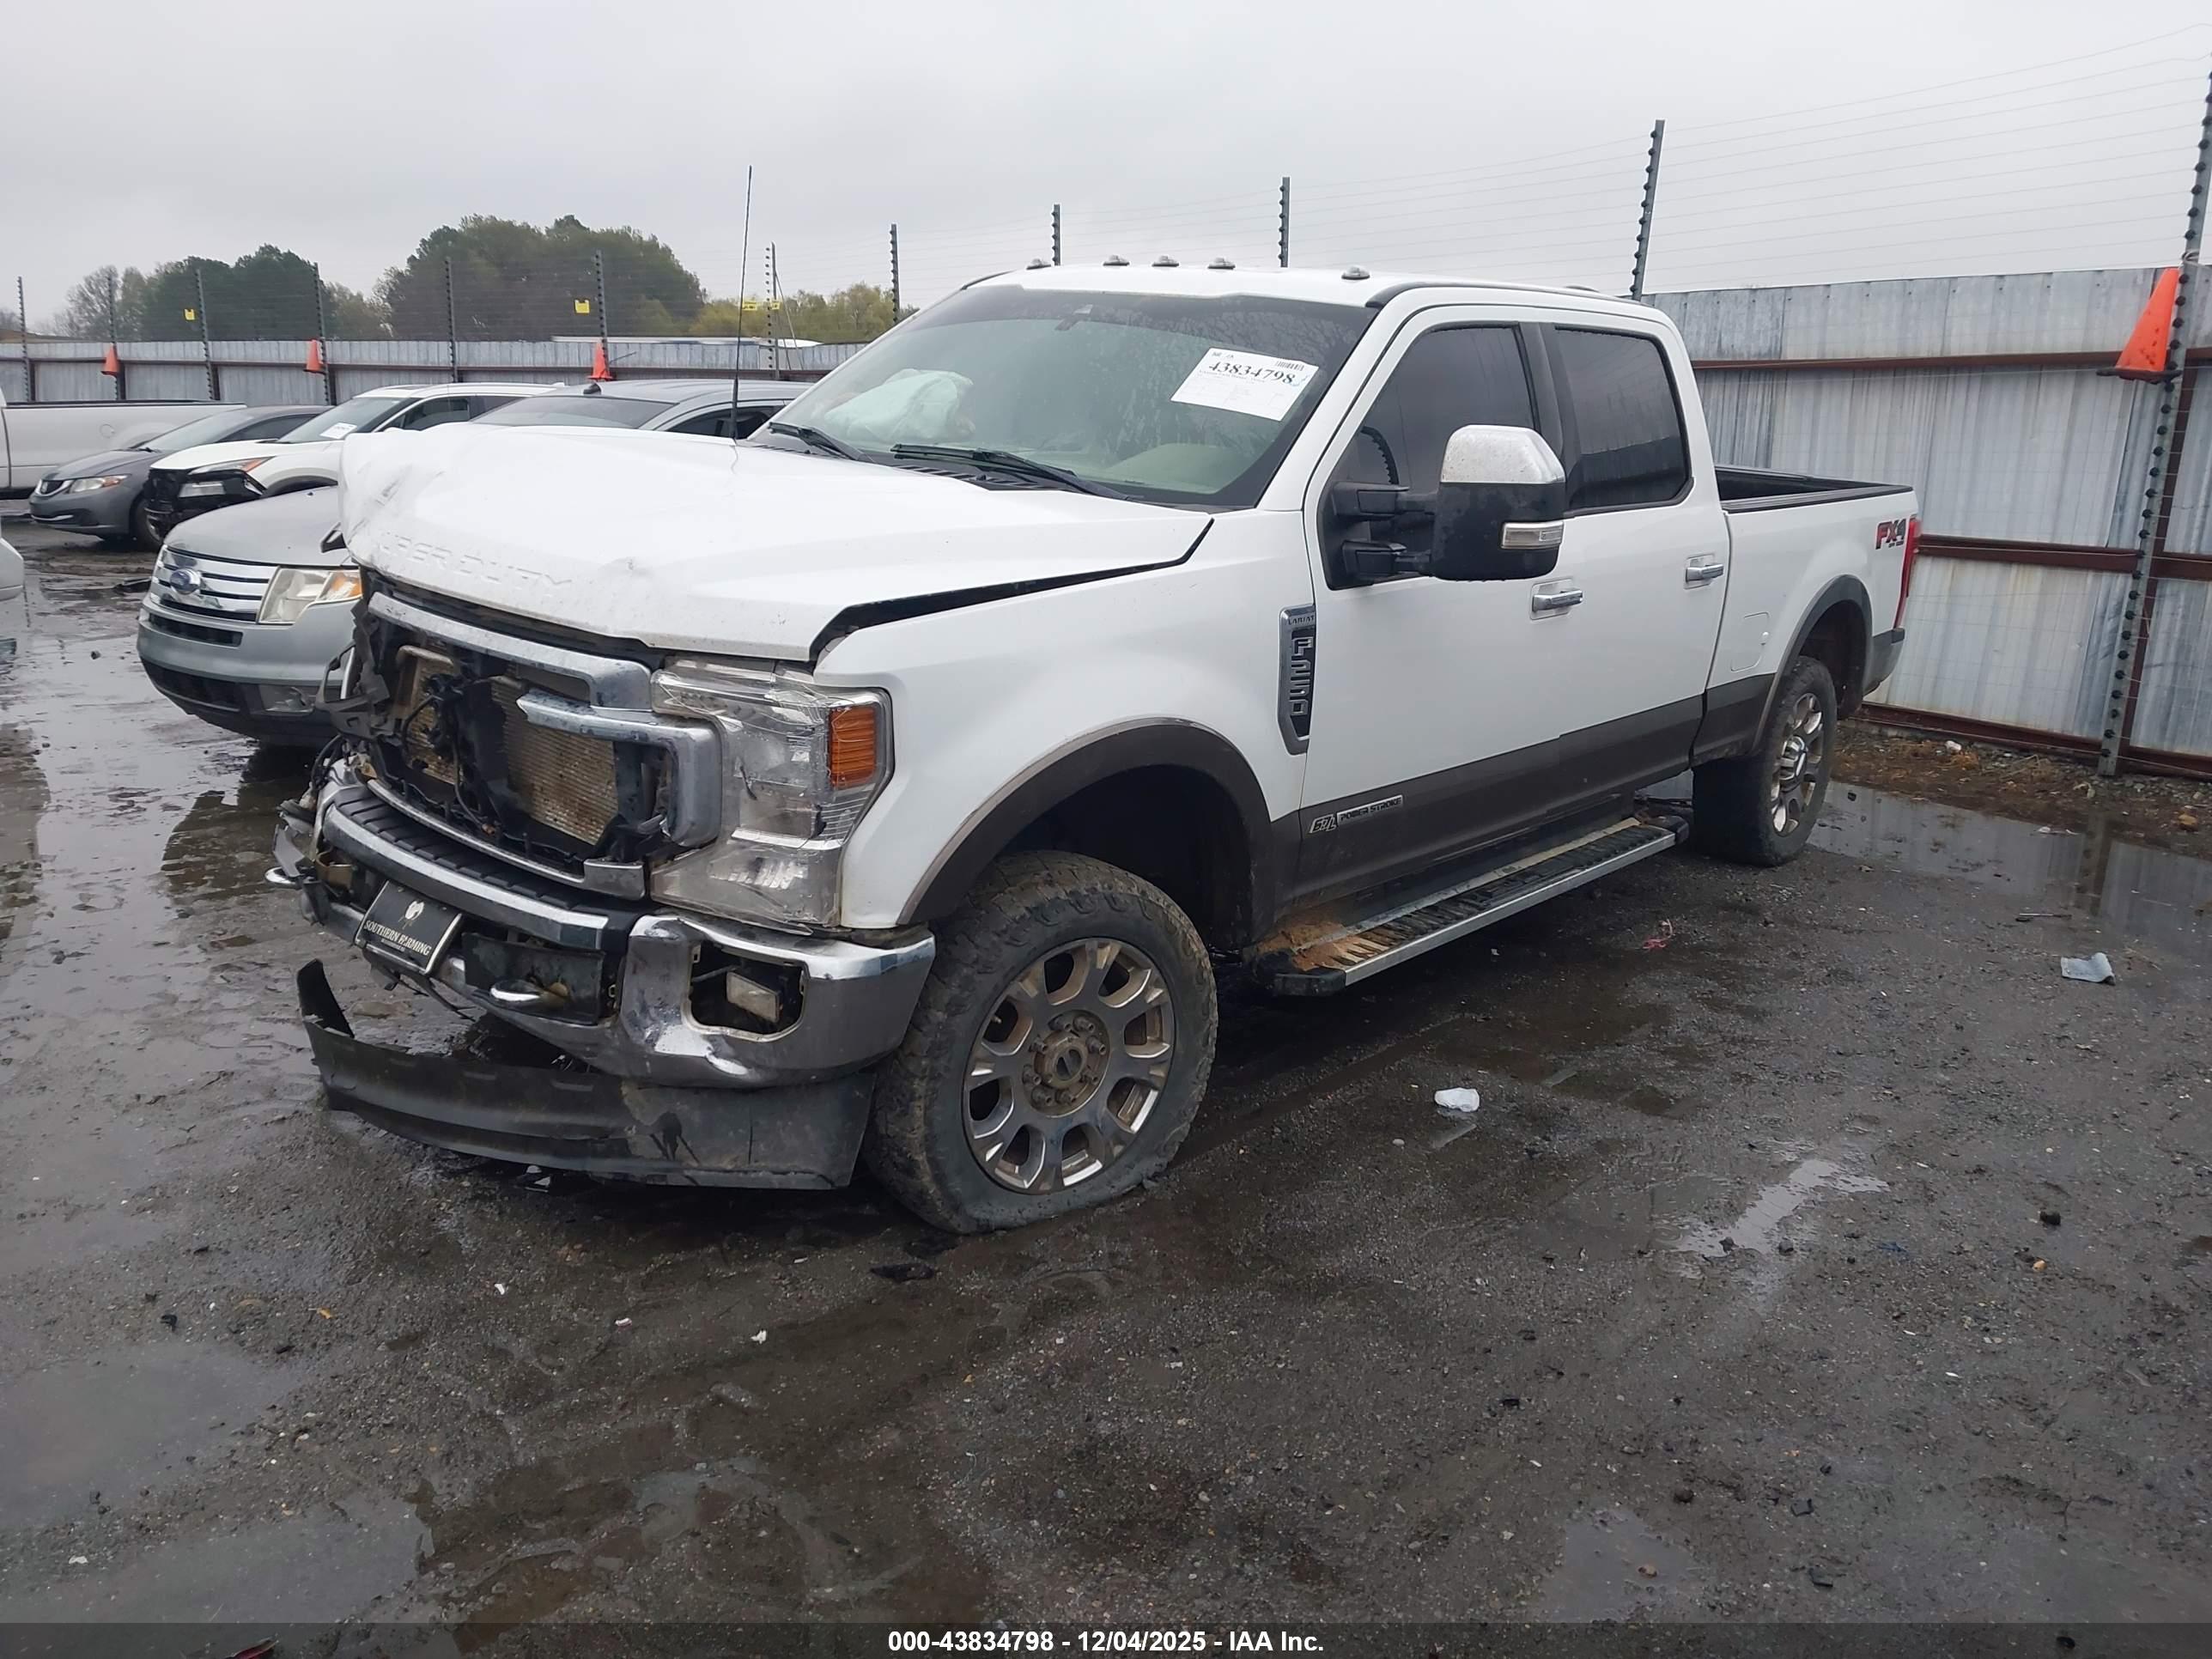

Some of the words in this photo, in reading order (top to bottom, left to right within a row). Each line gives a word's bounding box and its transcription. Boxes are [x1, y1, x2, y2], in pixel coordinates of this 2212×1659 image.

[1208, 362, 1296, 385] 43834798
[1875, 518, 1906, 550] FX4
[1288, 615, 1316, 626] LARIAT
[363, 920, 401, 944] SOUTHERN
